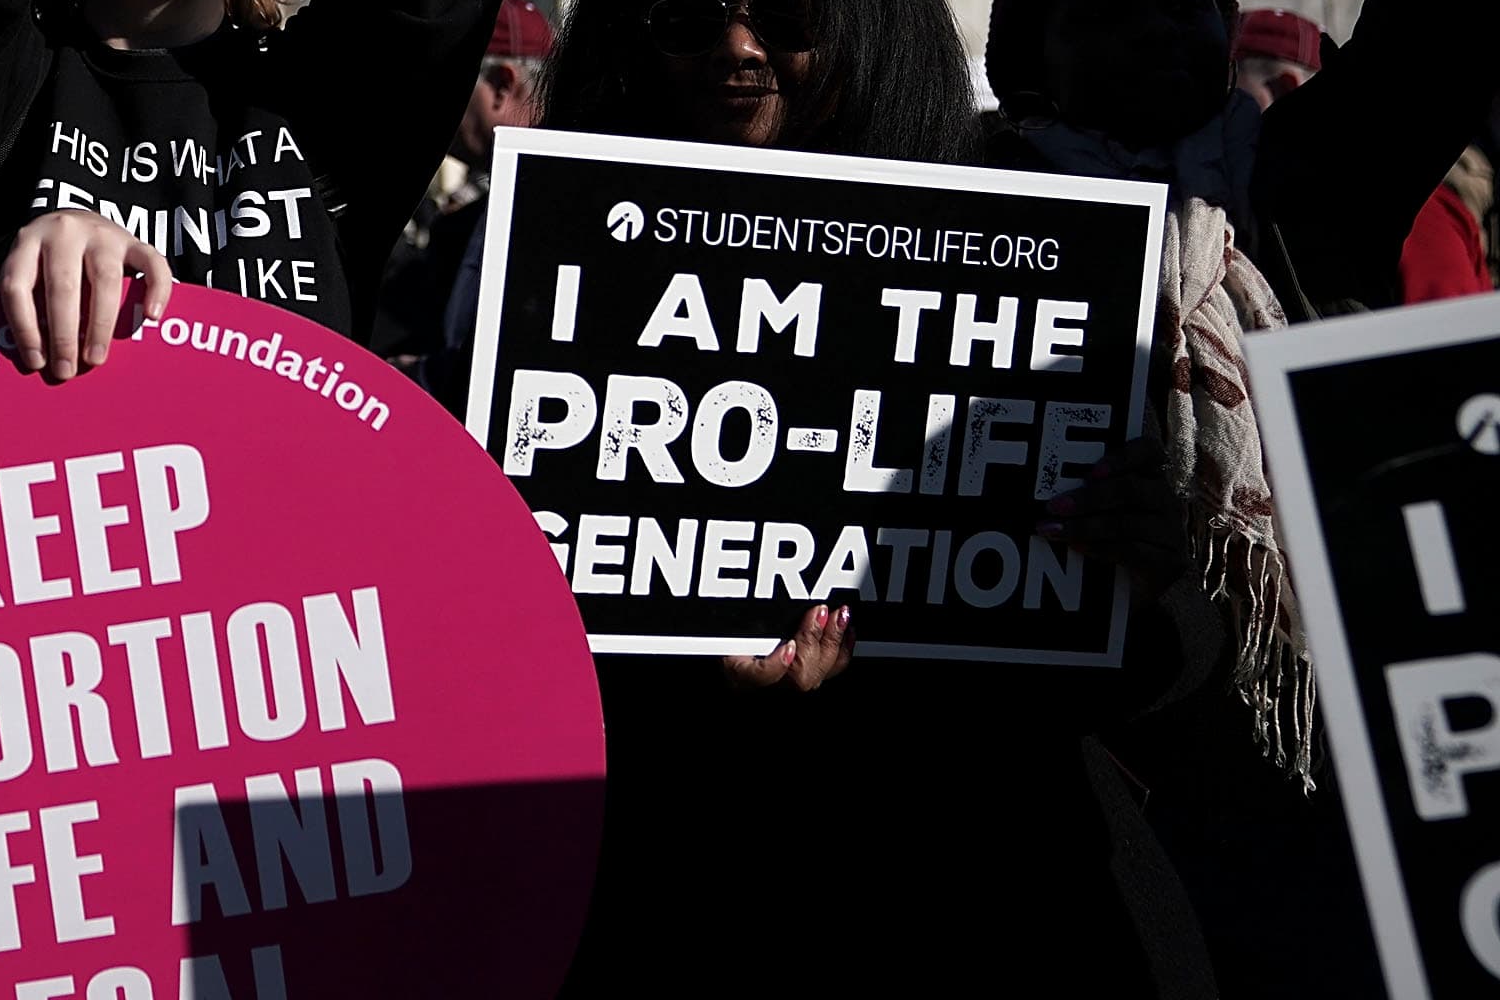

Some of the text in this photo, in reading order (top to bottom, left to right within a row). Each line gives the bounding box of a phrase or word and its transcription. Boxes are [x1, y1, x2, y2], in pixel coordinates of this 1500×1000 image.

[50, 121, 305, 186] HIS IS WHAT A
[653, 207, 1060, 271] STUDENTSFORLIFE.ORG
[132, 303, 391, 432] Foundation
[551, 264, 1089, 372] I AM THE
[502, 368, 1113, 501] PRO-LIFE
[1402, 501, 1465, 615] I
[171, 758, 414, 927] AND
